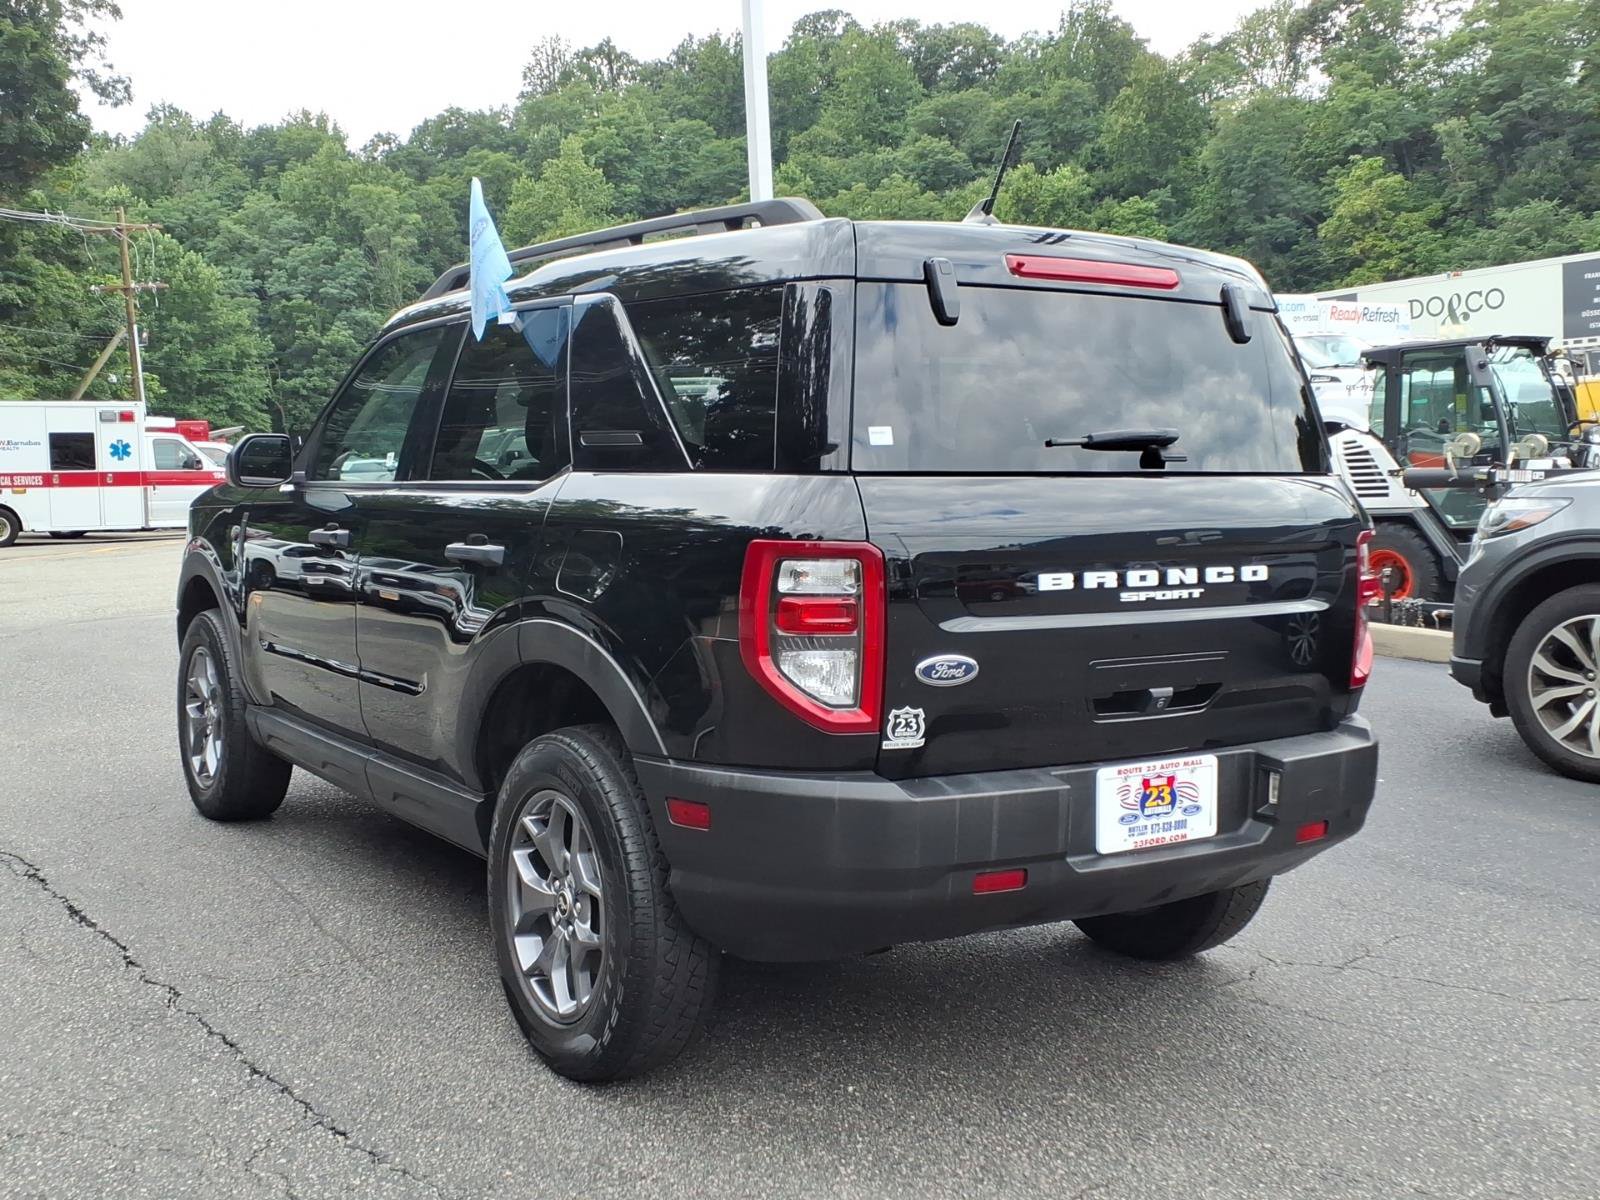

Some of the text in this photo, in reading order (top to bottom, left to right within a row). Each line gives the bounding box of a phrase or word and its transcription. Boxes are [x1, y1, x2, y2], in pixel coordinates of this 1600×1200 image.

[1330, 305, 1400, 324] ReadyRefresh
[13, 475, 43, 486] SERVICES
[1037, 565, 1268, 591] BRONCO
[1119, 588, 1205, 602] SPORT
[895, 718, 918, 732] 23
[1117, 766, 1143, 776] ROUTE
[1159, 761, 1180, 770] AUTO
[1182, 759, 1203, 767] MALL
[1145, 785, 1171, 808] 23
[1133, 833, 1188, 848] 23FORD.COM
